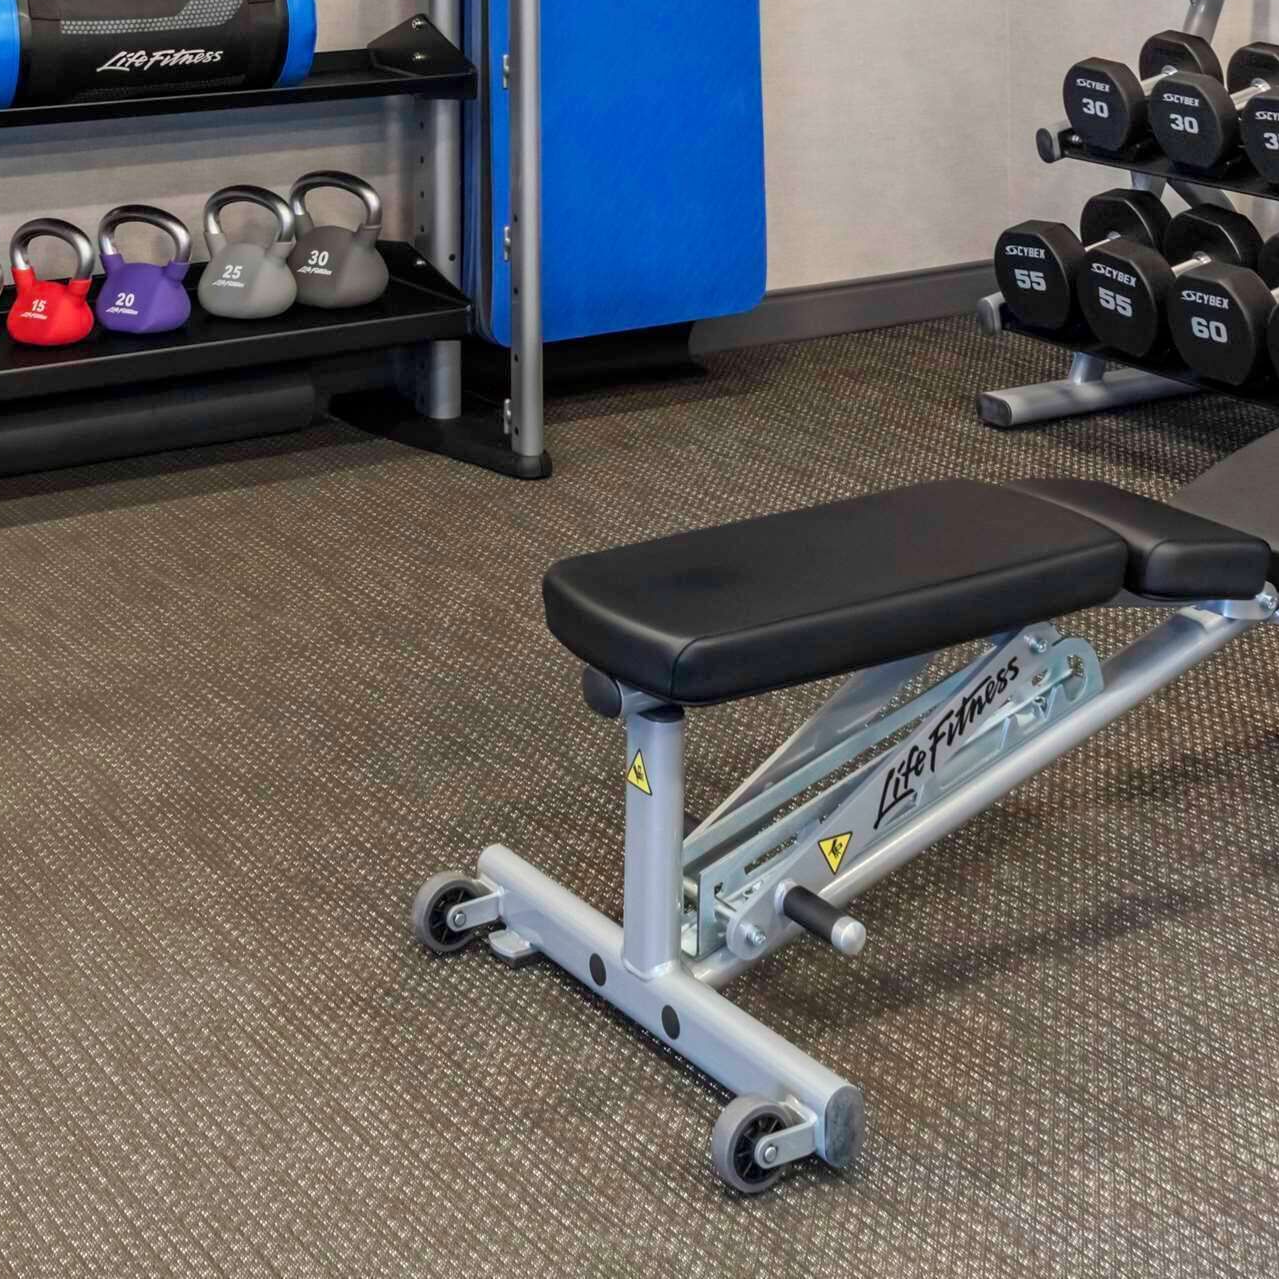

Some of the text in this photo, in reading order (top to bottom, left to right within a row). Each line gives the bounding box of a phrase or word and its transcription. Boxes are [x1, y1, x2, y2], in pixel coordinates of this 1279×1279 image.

[96, 47, 224, 72] Life Fitness
[1082, 98, 1109, 119] 30
[1174, 94, 1200, 107] CYBEX
[1169, 113, 1199, 135] 30
[308, 250, 329, 266] 30
[1018, 246, 1045, 260] CYBEX
[222, 265, 243, 279] 25
[1014, 269, 1047, 292] 55
[1104, 266, 1137, 288] CYBEX
[31, 299, 47, 312] 15
[115, 293, 135, 307] 20
[1098, 286, 1134, 318] 55
[1195, 292, 1230, 311] CYBEX
[1191, 316, 1229, 343] 60
[873, 656, 1021, 830] Life Fitness
